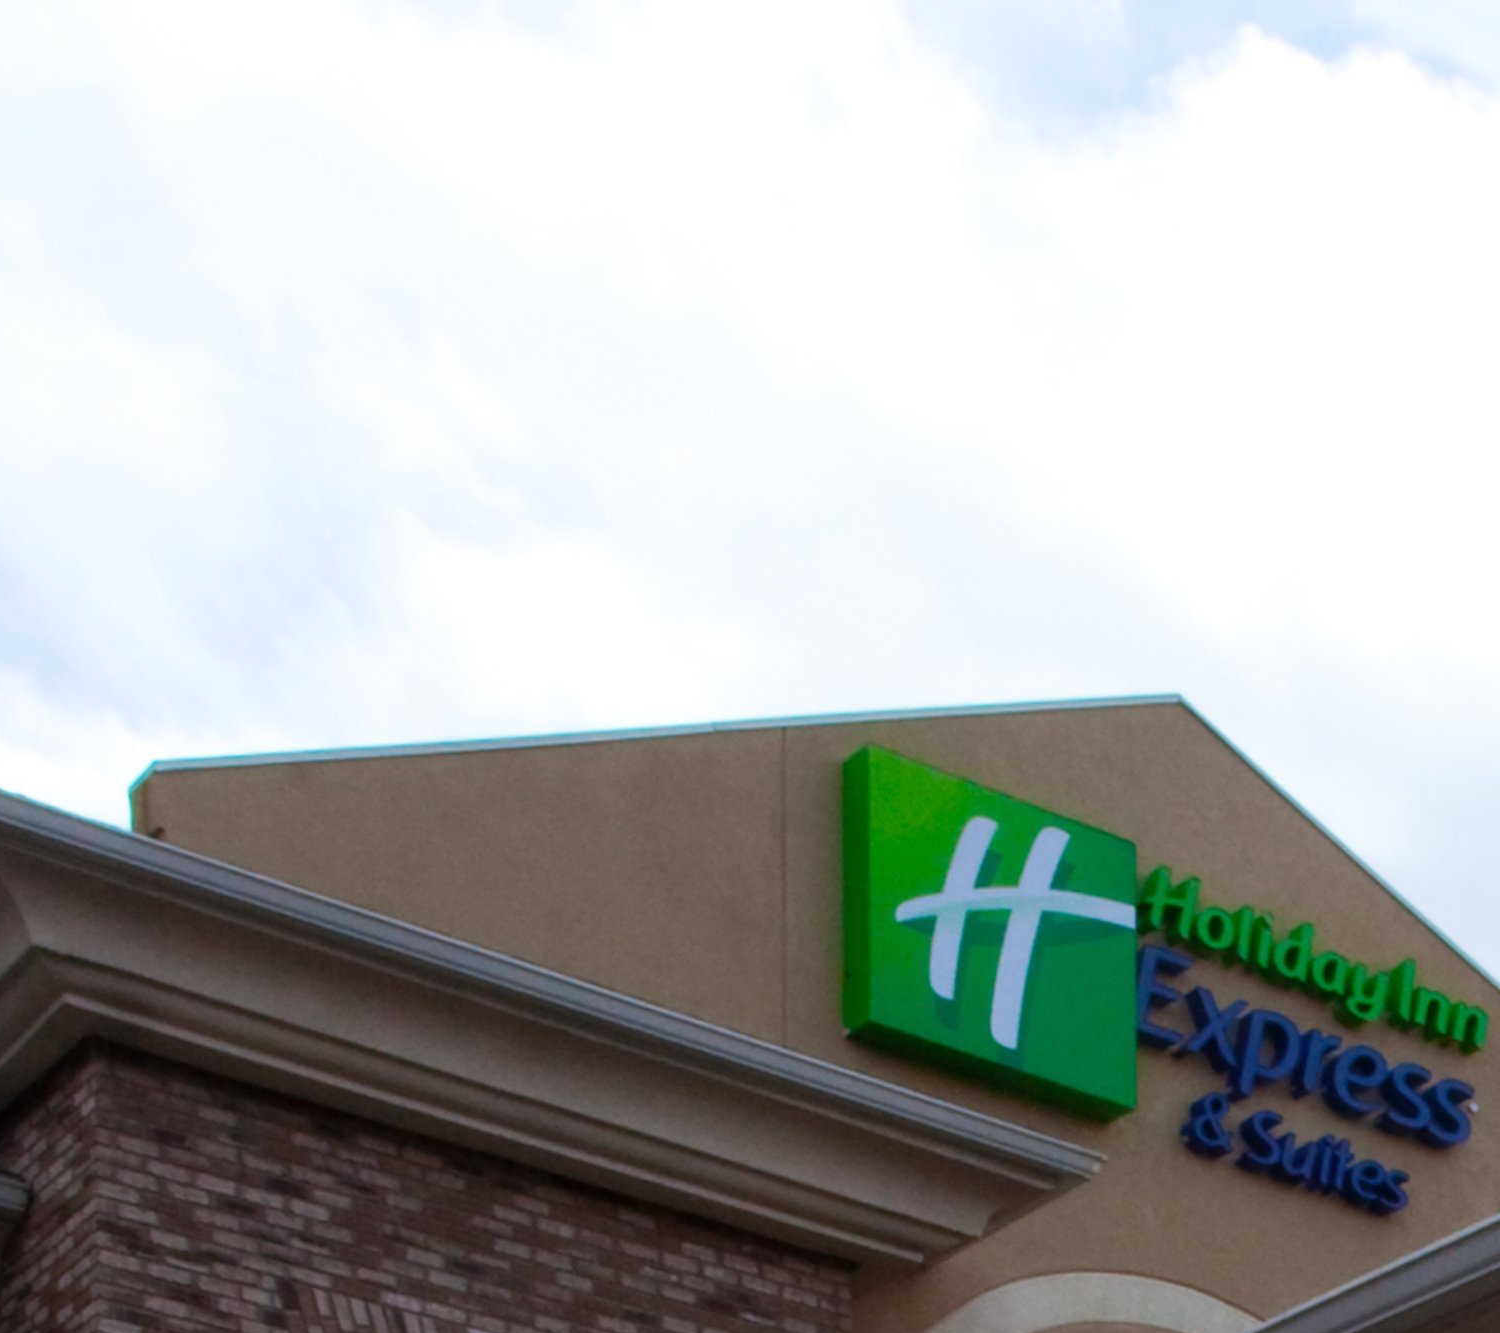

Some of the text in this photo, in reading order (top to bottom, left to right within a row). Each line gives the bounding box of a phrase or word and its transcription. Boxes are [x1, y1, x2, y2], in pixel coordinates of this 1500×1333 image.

[1136, 943, 1474, 1149] Express
[1138, 866, 1488, 1054] Holiday Inn
[1180, 1091, 1409, 1215] & Suites
